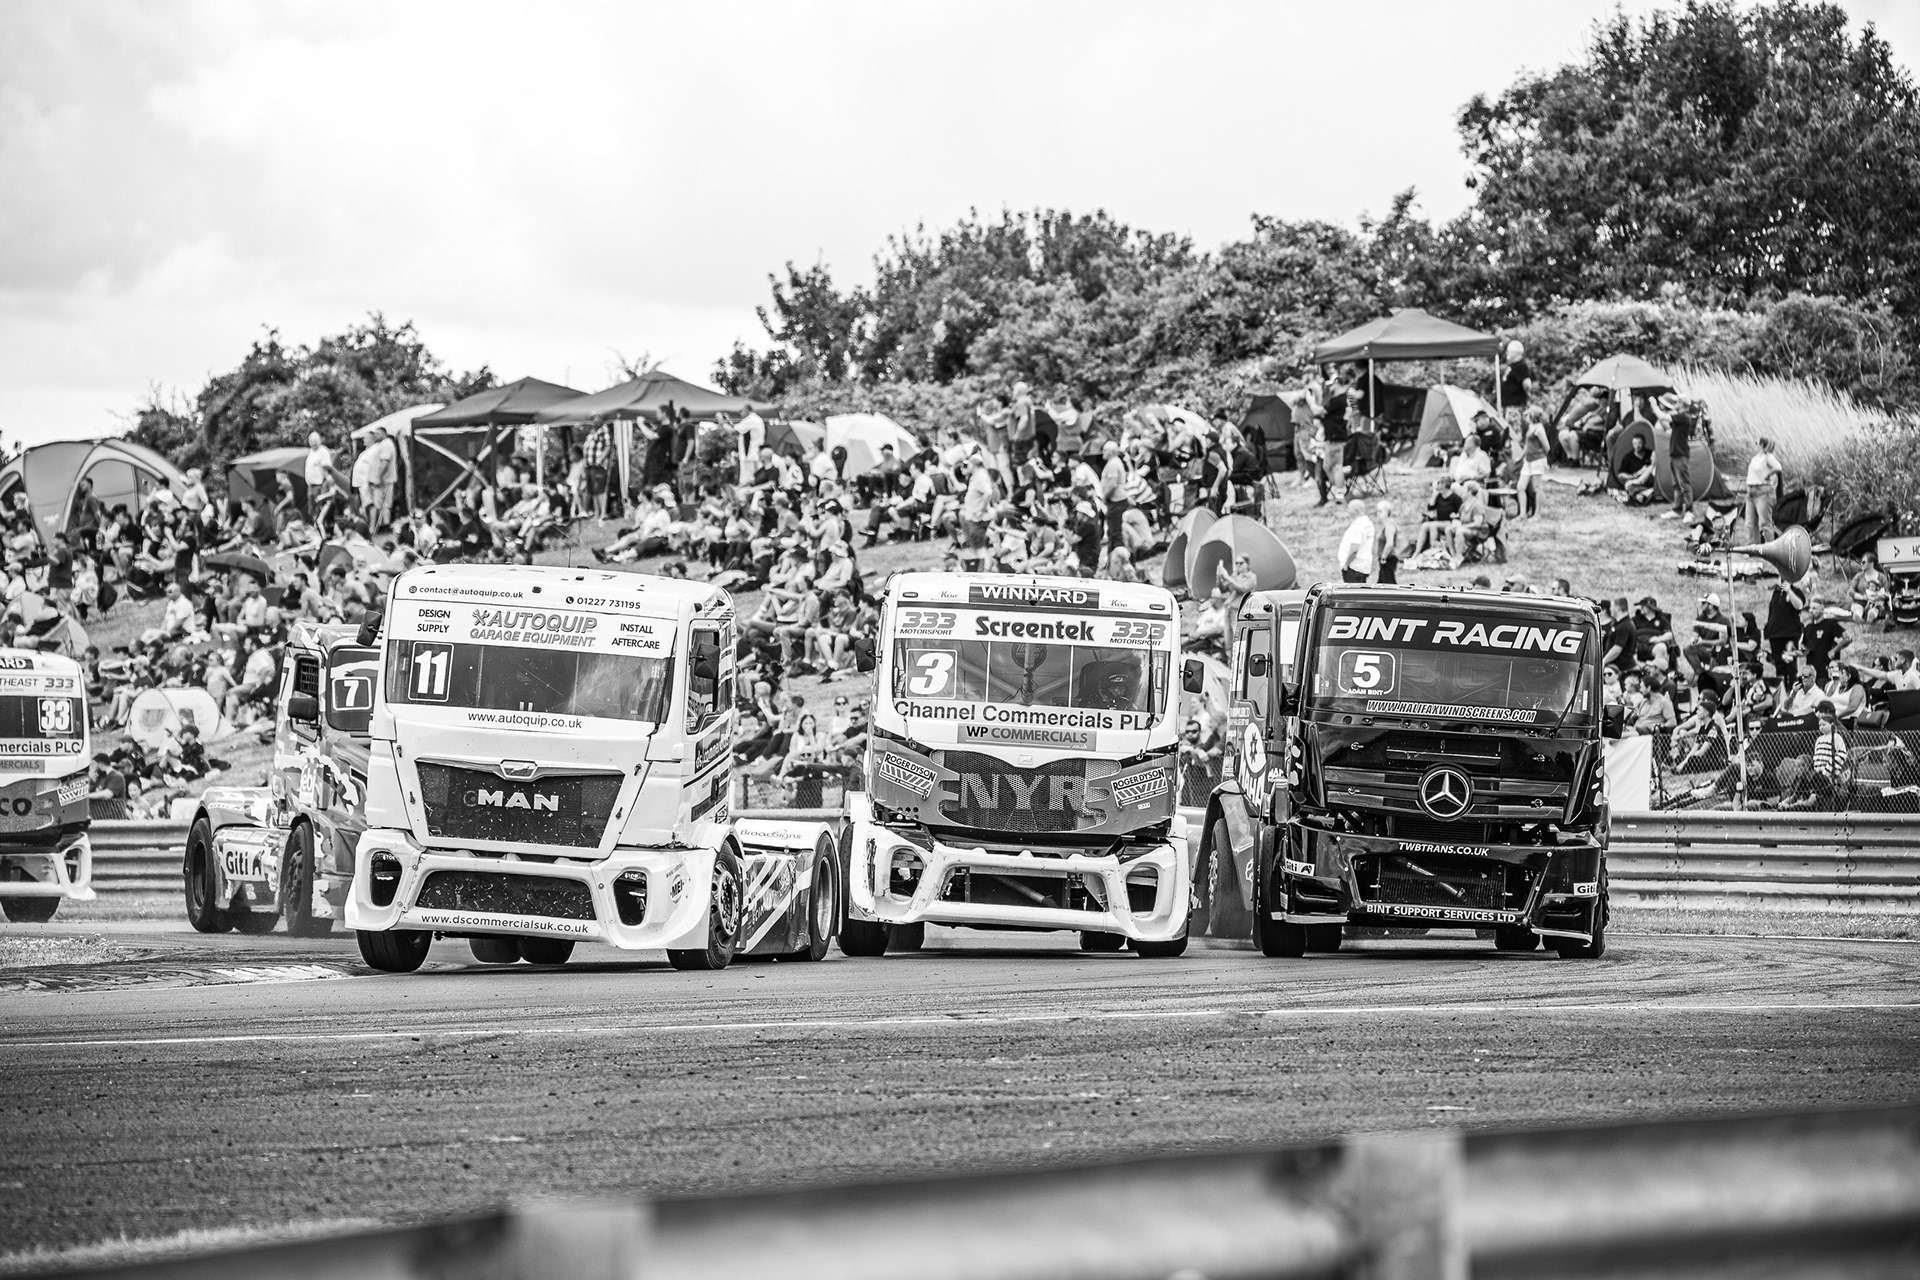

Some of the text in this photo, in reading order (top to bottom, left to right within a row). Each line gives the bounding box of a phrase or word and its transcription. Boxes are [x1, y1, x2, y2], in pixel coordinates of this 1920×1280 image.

[419, 587, 524, 599] contact@autoquip.co.uk
[981, 585, 1088, 604] WINNARD
[576, 597, 641, 609] 01227 731195
[418, 609, 451, 618] DESIGN
[487, 611, 598, 633] AUTOQUIP
[902, 611, 957, 628] 333
[417, 623, 450, 633] SUPPLY
[470, 628, 596, 647] GARAGE EQUIPMENT
[620, 623, 653, 634] INSTALL
[975, 616, 1095, 642] Screentek
[1111, 621, 1166, 640] 333
[1327, 615, 1584, 654] BINT RACING
[611, 638, 660, 649] AFTERCARE
[1109, 638, 1162, 646] MOTORSPORT
[415, 650, 448, 695] 11
[909, 652, 954, 695] 3
[1352, 654, 1381, 688] 5
[343, 679, 359, 707] 7
[41, 700, 70, 731] 33
[468, 712, 582, 728] www.autoquip.co.uk
[895, 701, 975, 720] Channel
[983, 705, 1113, 729] Commercials
[1366, 700, 1537, 722] WWW.HALIFAXWINDSCREENS.COM
[967, 725, 1088, 743] WP COMMERCIALS
[56, 742, 81, 753] PLC
[885, 753, 936, 782] ROGER DYSON
[1112, 768, 1165, 791] ROGER DYSON
[477, 789, 559, 811] MAN
[1399, 842, 1490, 857] TWBTRANS.CO.UK
[225, 850, 249, 876] Giti
[1366, 904, 1516, 923] BINT SUPPORT SERVICES LTD
[421, 914, 589, 933] www.dscommercialsuk.co.uk
